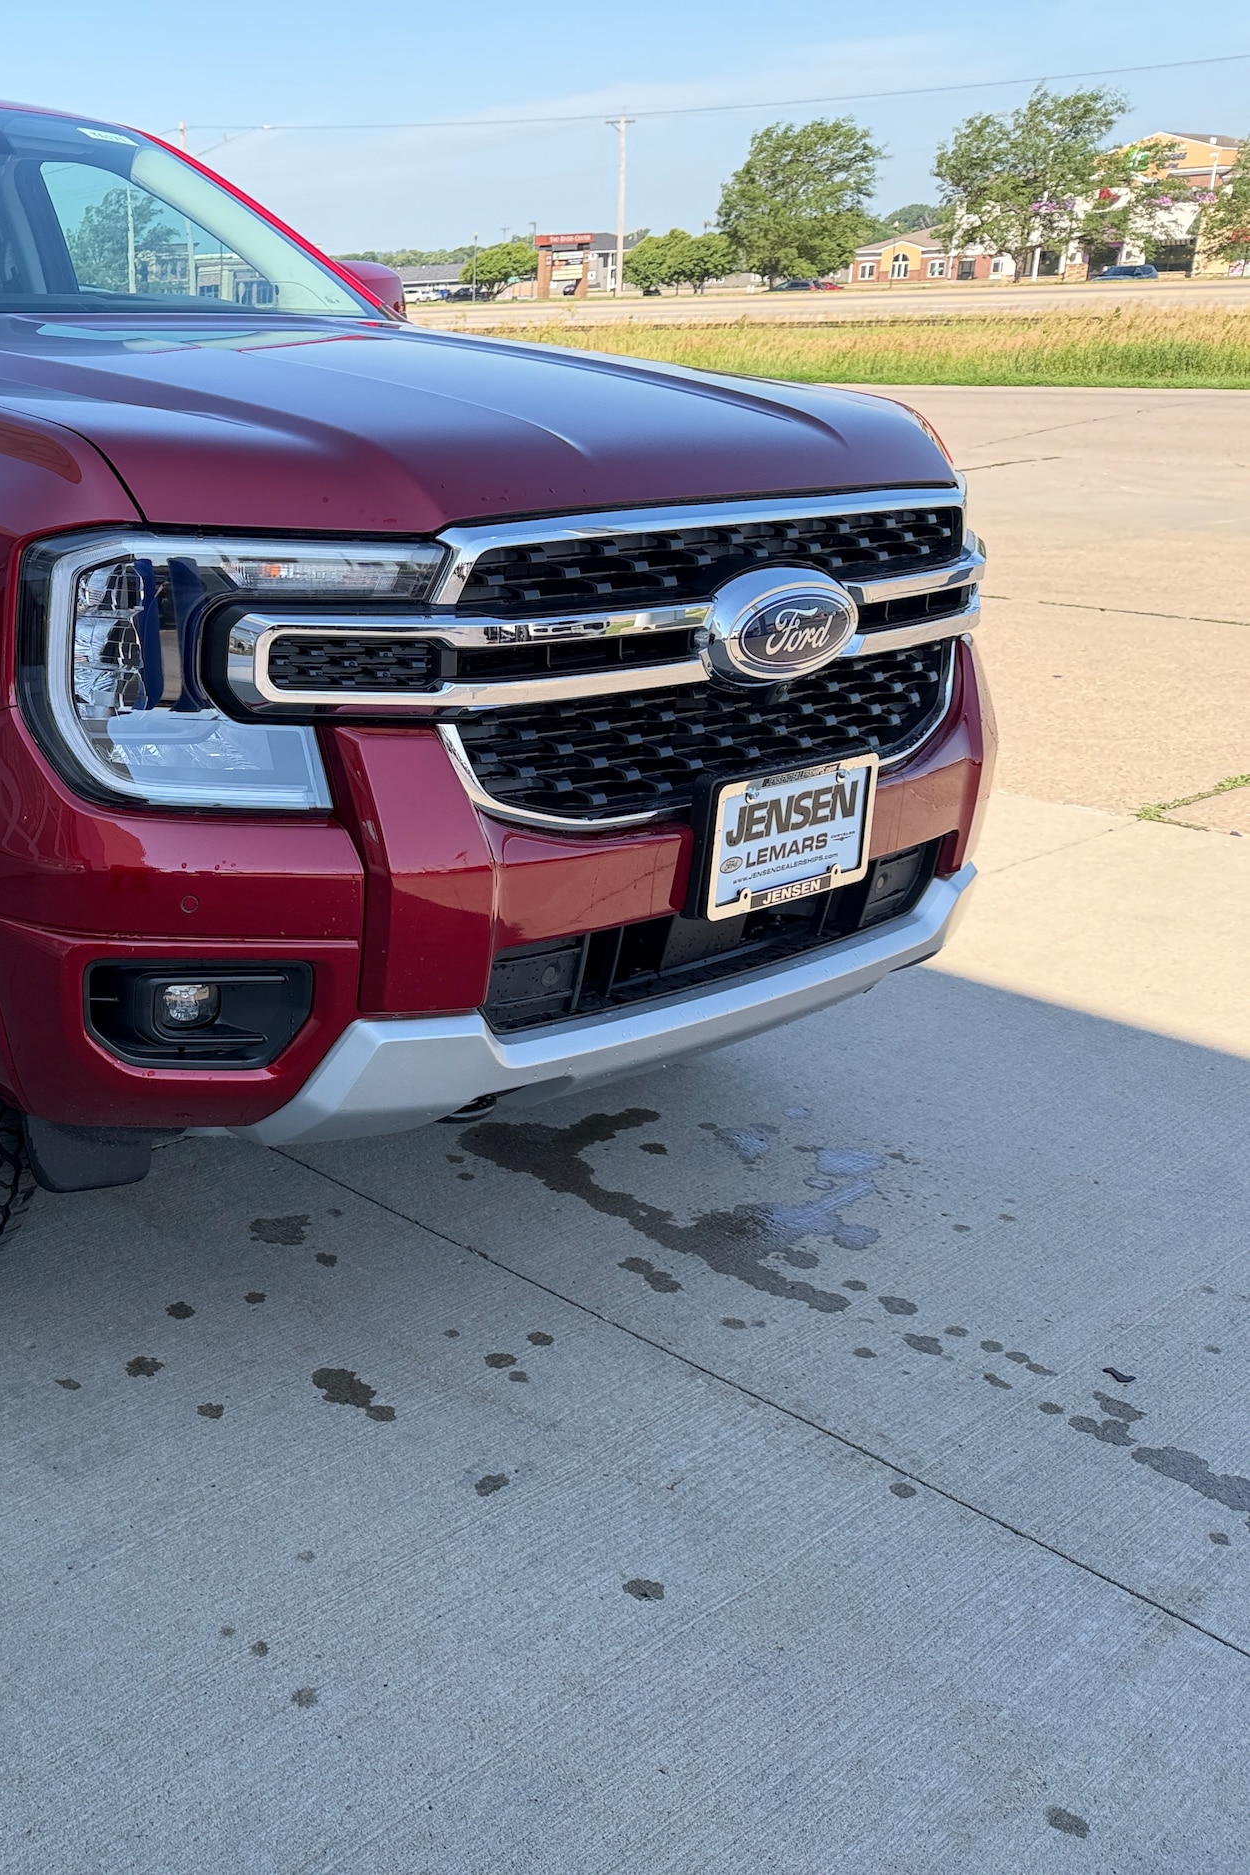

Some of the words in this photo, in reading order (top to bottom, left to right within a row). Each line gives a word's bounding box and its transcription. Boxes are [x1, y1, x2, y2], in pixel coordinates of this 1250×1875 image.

[765, 607, 837, 656] Ford
[725, 779, 859, 847] JENSEN
[732, 853, 838, 885] www.JENSENDEALERSHIPS.com
[745, 832, 828, 869] LEMARS
[762, 878, 821, 905] JENSEN
